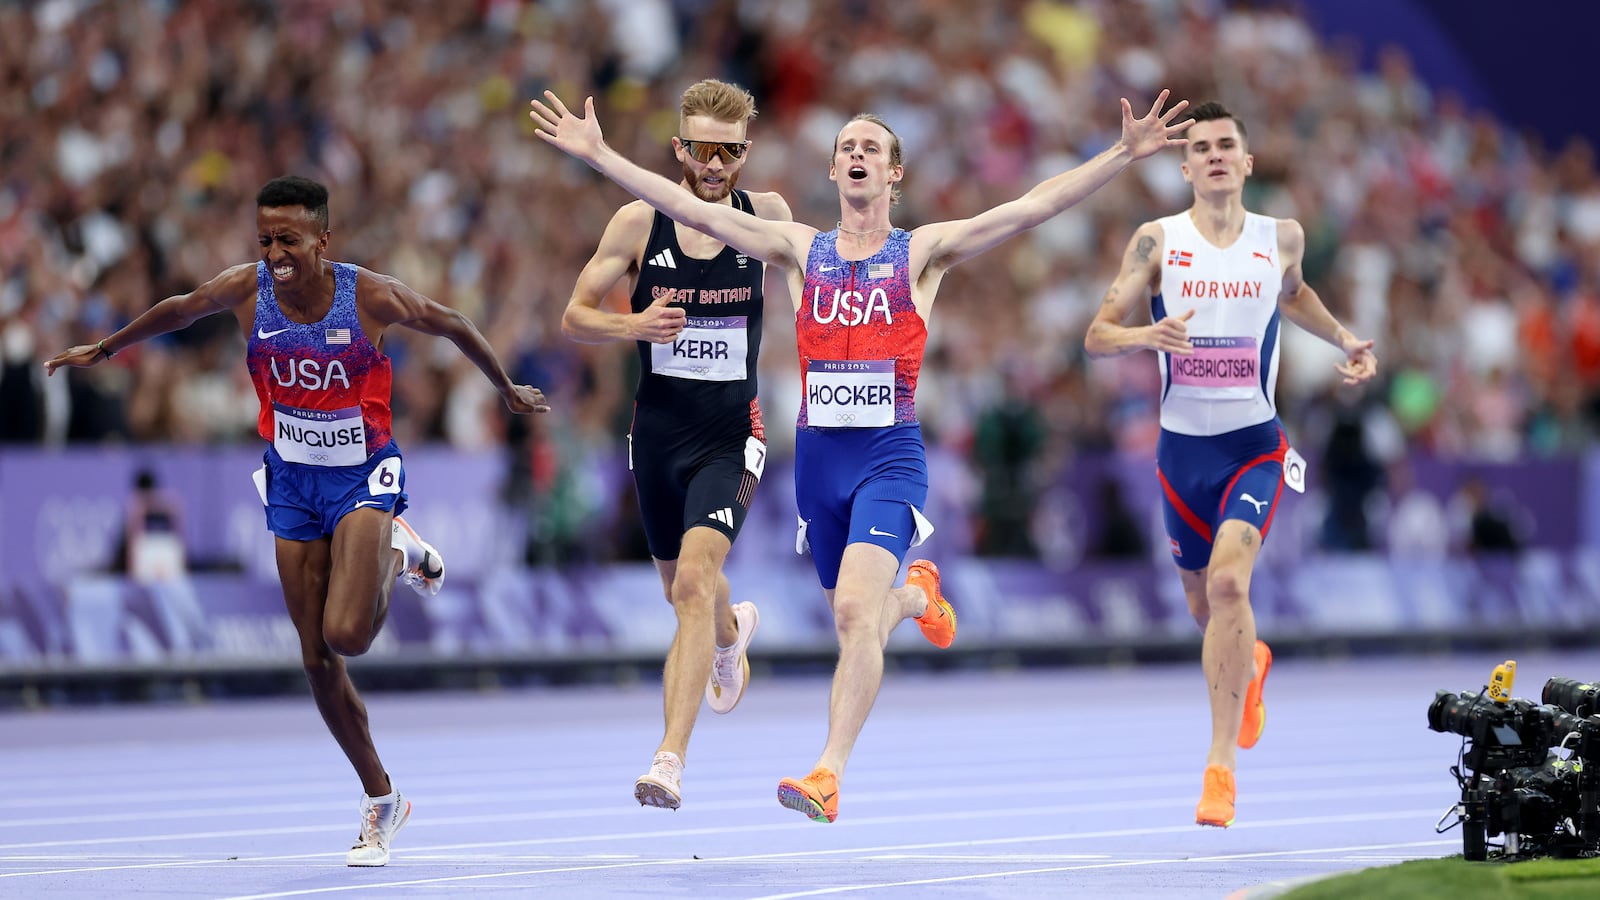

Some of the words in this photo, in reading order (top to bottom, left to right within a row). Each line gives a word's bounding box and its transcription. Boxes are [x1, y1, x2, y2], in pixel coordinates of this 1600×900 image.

[699, 286, 752, 304] BRITAIN
[1182, 280, 1262, 299] NORWAY
[813, 286, 893, 327] USA
[673, 339, 729, 360] KERR
[271, 356, 351, 391] USA
[823, 362, 845, 370] PARIS
[847, 362, 871, 370] 2024
[1172, 357, 1256, 379] INGEBRIGTSEN
[809, 384, 892, 406] HOCKER
[292, 409, 314, 419] PARIS
[316, 412, 338, 420] 2024
[279, 420, 363, 448] NUGUSE
[755, 447, 765, 469] 7
[379, 466, 394, 488] 6
